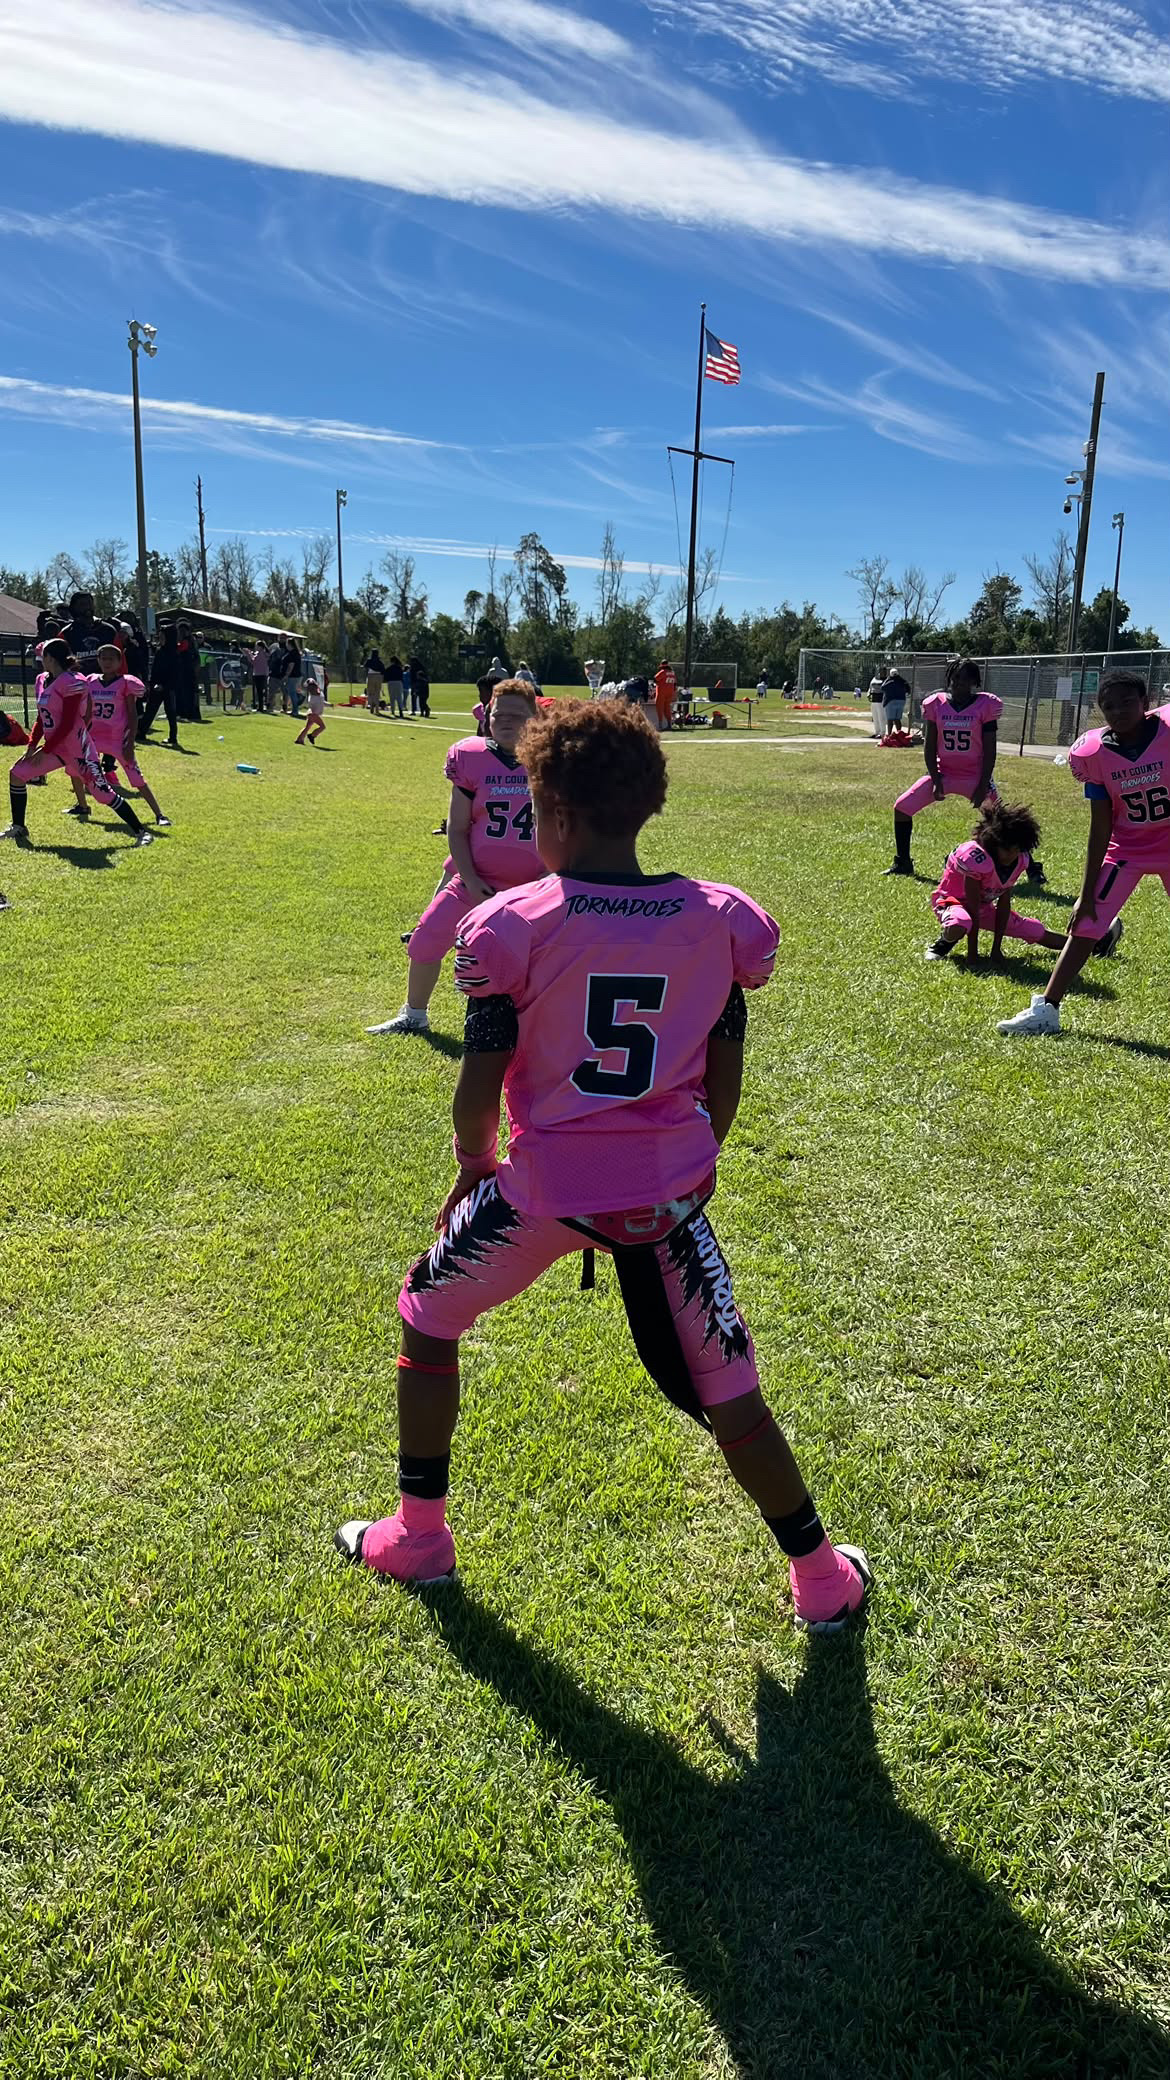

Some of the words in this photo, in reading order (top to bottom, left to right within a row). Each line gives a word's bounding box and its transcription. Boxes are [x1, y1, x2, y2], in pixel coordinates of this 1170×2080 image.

[94, 702, 115, 720] 33
[942, 729, 972, 752] 55
[485, 775, 502, 784] BAY
[505, 775, 528, 784] COUN
[1112, 769, 1127, 781] BAY
[1129, 760, 1165, 776] COUNTY
[1120, 771, 1161, 790] TORNADOES
[1119, 785, 1170, 824] 56
[484, 799, 536, 842] 54
[563, 894, 686, 924] TORNADOES
[569, 973, 669, 1101] 5
